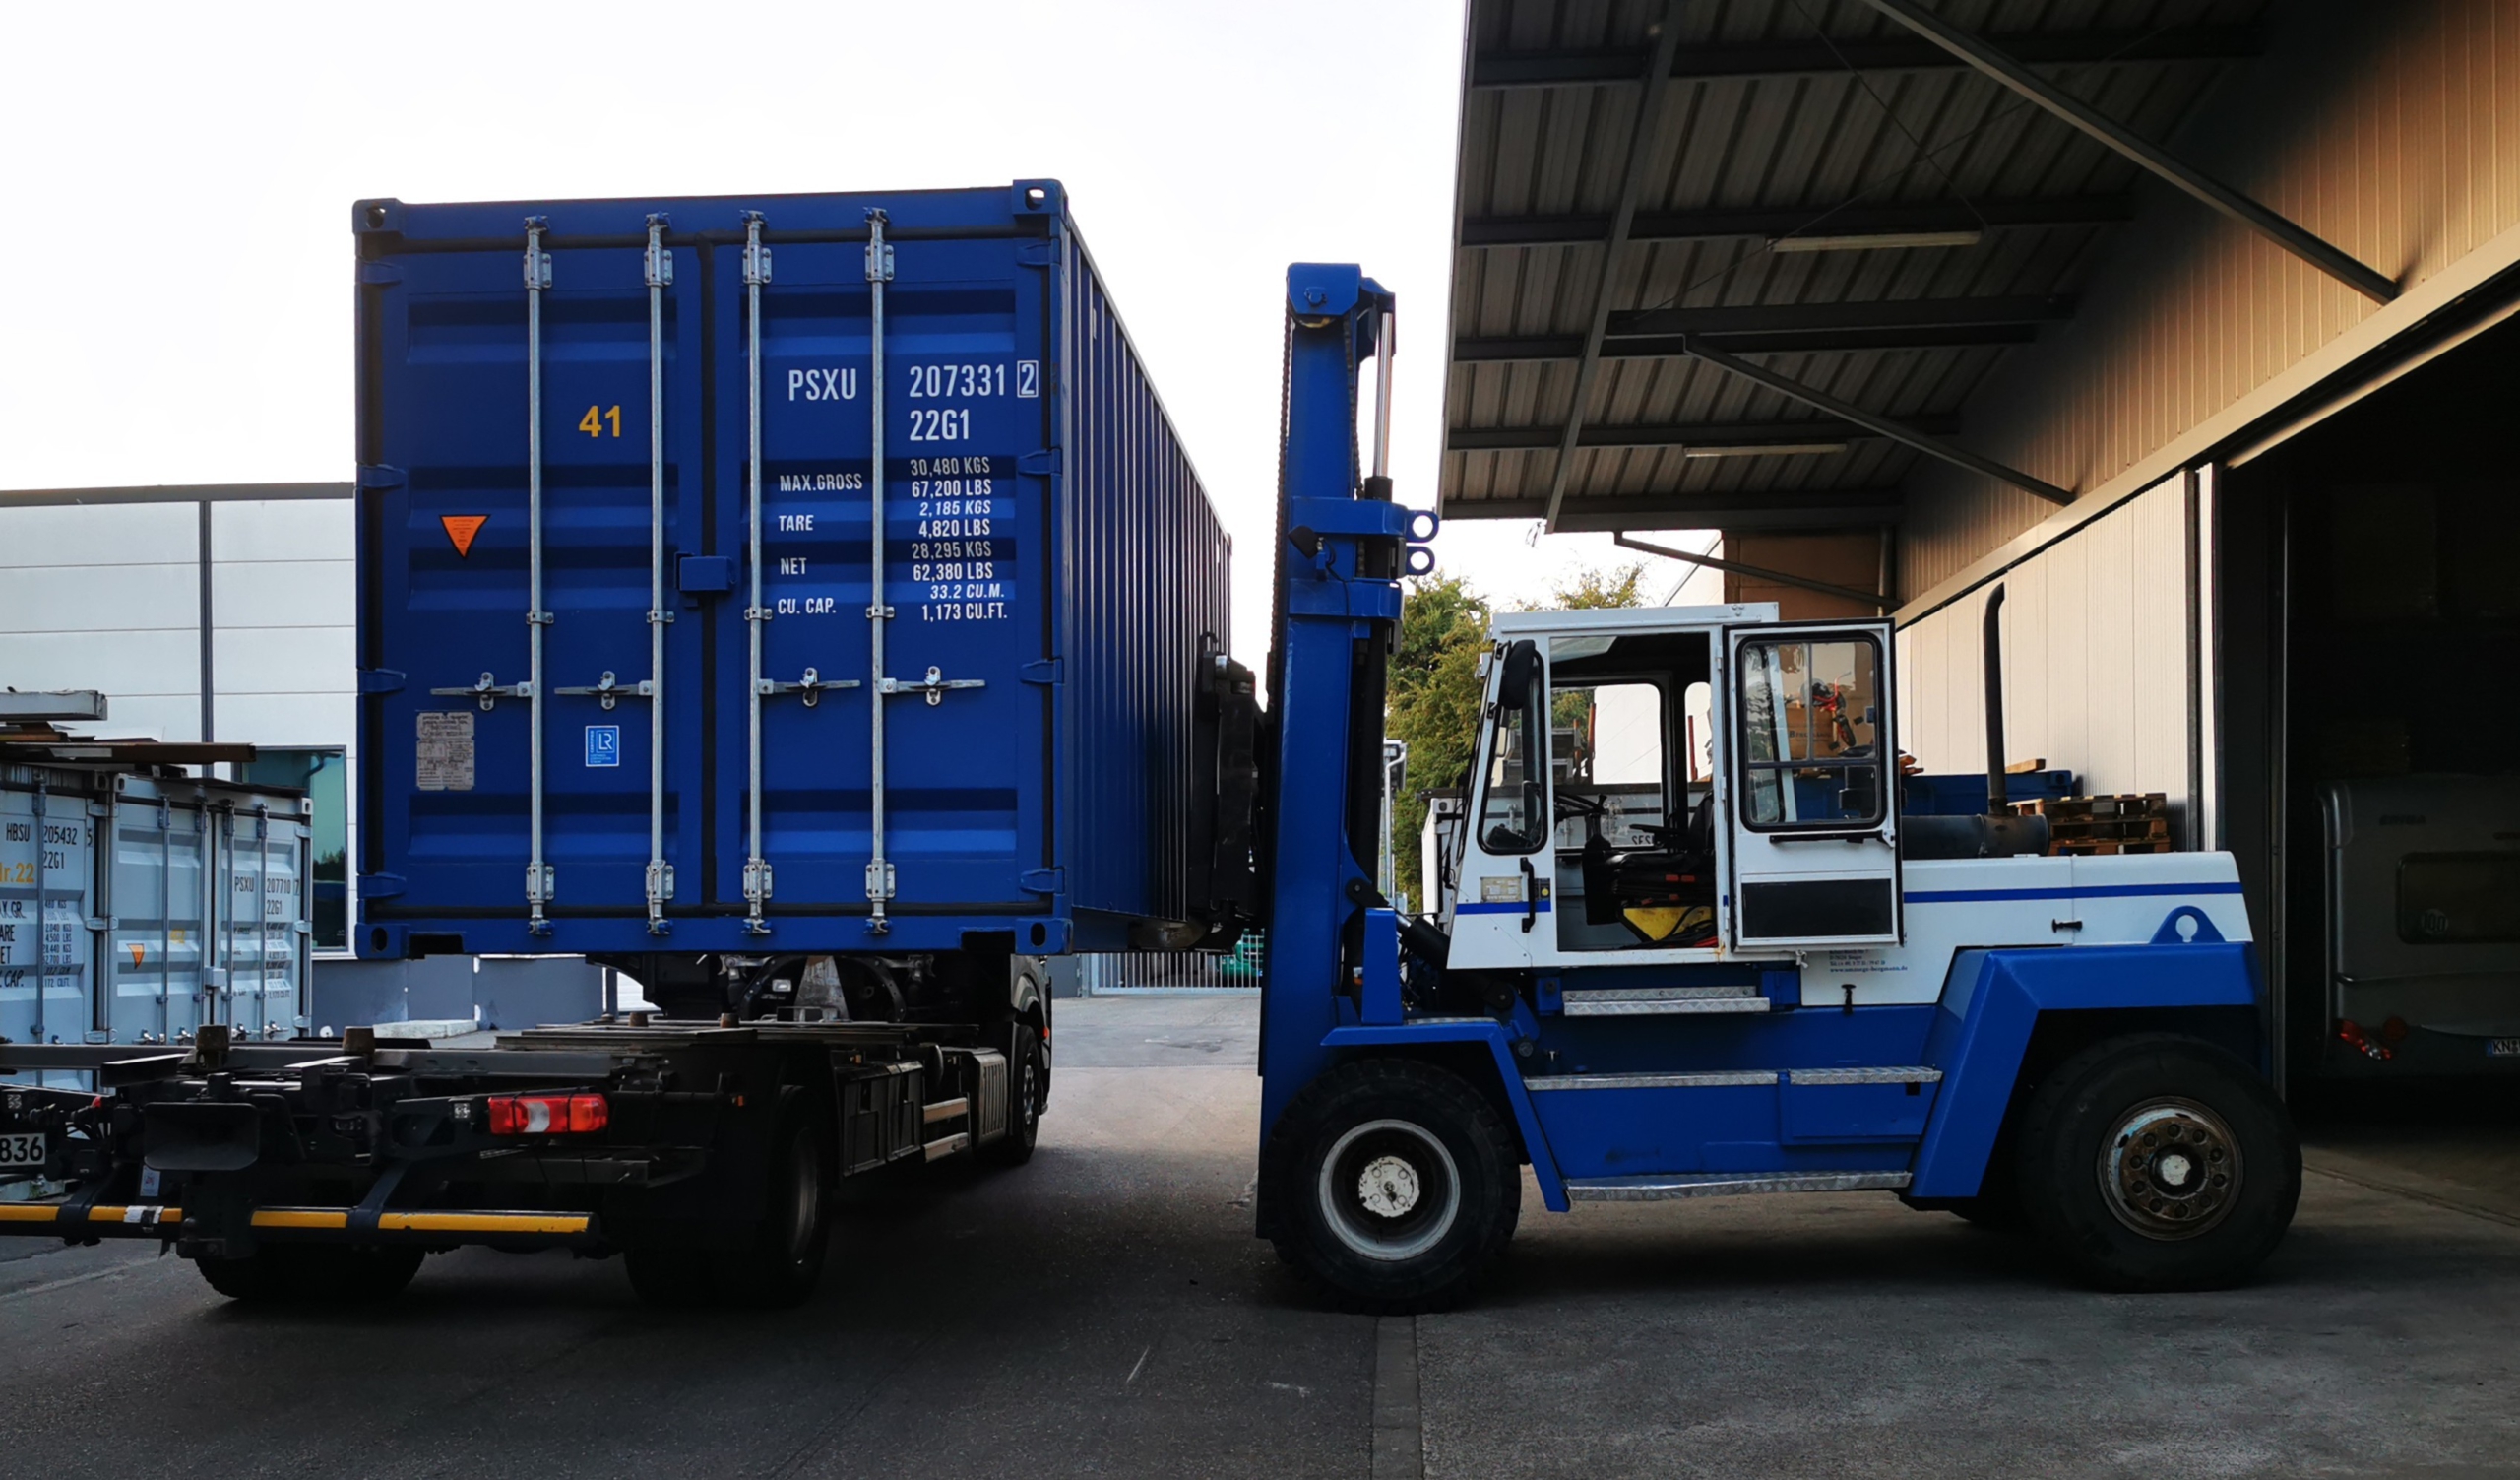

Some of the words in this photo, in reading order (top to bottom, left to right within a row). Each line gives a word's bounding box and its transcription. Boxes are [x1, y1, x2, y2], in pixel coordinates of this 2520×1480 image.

[788, 368, 857, 401] PSXU
[909, 364, 1005, 399] 207331
[1020, 362, 1037, 396] 2
[578, 404, 621, 438] 41
[909, 409, 969, 441] 22G1
[910, 457, 959, 477] 30,480
[963, 456, 990, 474] KGS
[780, 473, 862, 492] MAX.GROSS
[912, 480, 961, 499] 67,200
[965, 479, 991, 496] LBS
[919, 501, 960, 518] 2,185
[965, 500, 990, 515] KGS
[779, 515, 813, 532] TARE
[918, 519, 960, 539] 4,820
[964, 519, 990, 536] LBS
[912, 542, 961, 561] 28,295
[966, 541, 992, 557] KGS
[780, 558, 807, 575] NET
[913, 563, 963, 583] 62,380
[966, 562, 993, 580] LBS
[929, 585, 962, 600] 33.2
[966, 584, 1005, 598] CU.M.
[778, 599, 801, 615] CU.
[805, 598, 836, 614] CAP.
[921, 604, 961, 622] 1,173
[966, 603, 1008, 619] CU.FT.
[6, 822, 31, 843] HBSU
[43, 825, 78, 845] 205432
[43, 851, 65, 869] 22G1
[234, 876, 255, 893] PSXU
[266, 877, 291, 894] 207710
[266, 900, 283, 915] 22G1
[4, 969, 25, 988] CAP.
[2492, 1040, 2511, 1053] KN
[0, 1136, 43, 1163] 836
